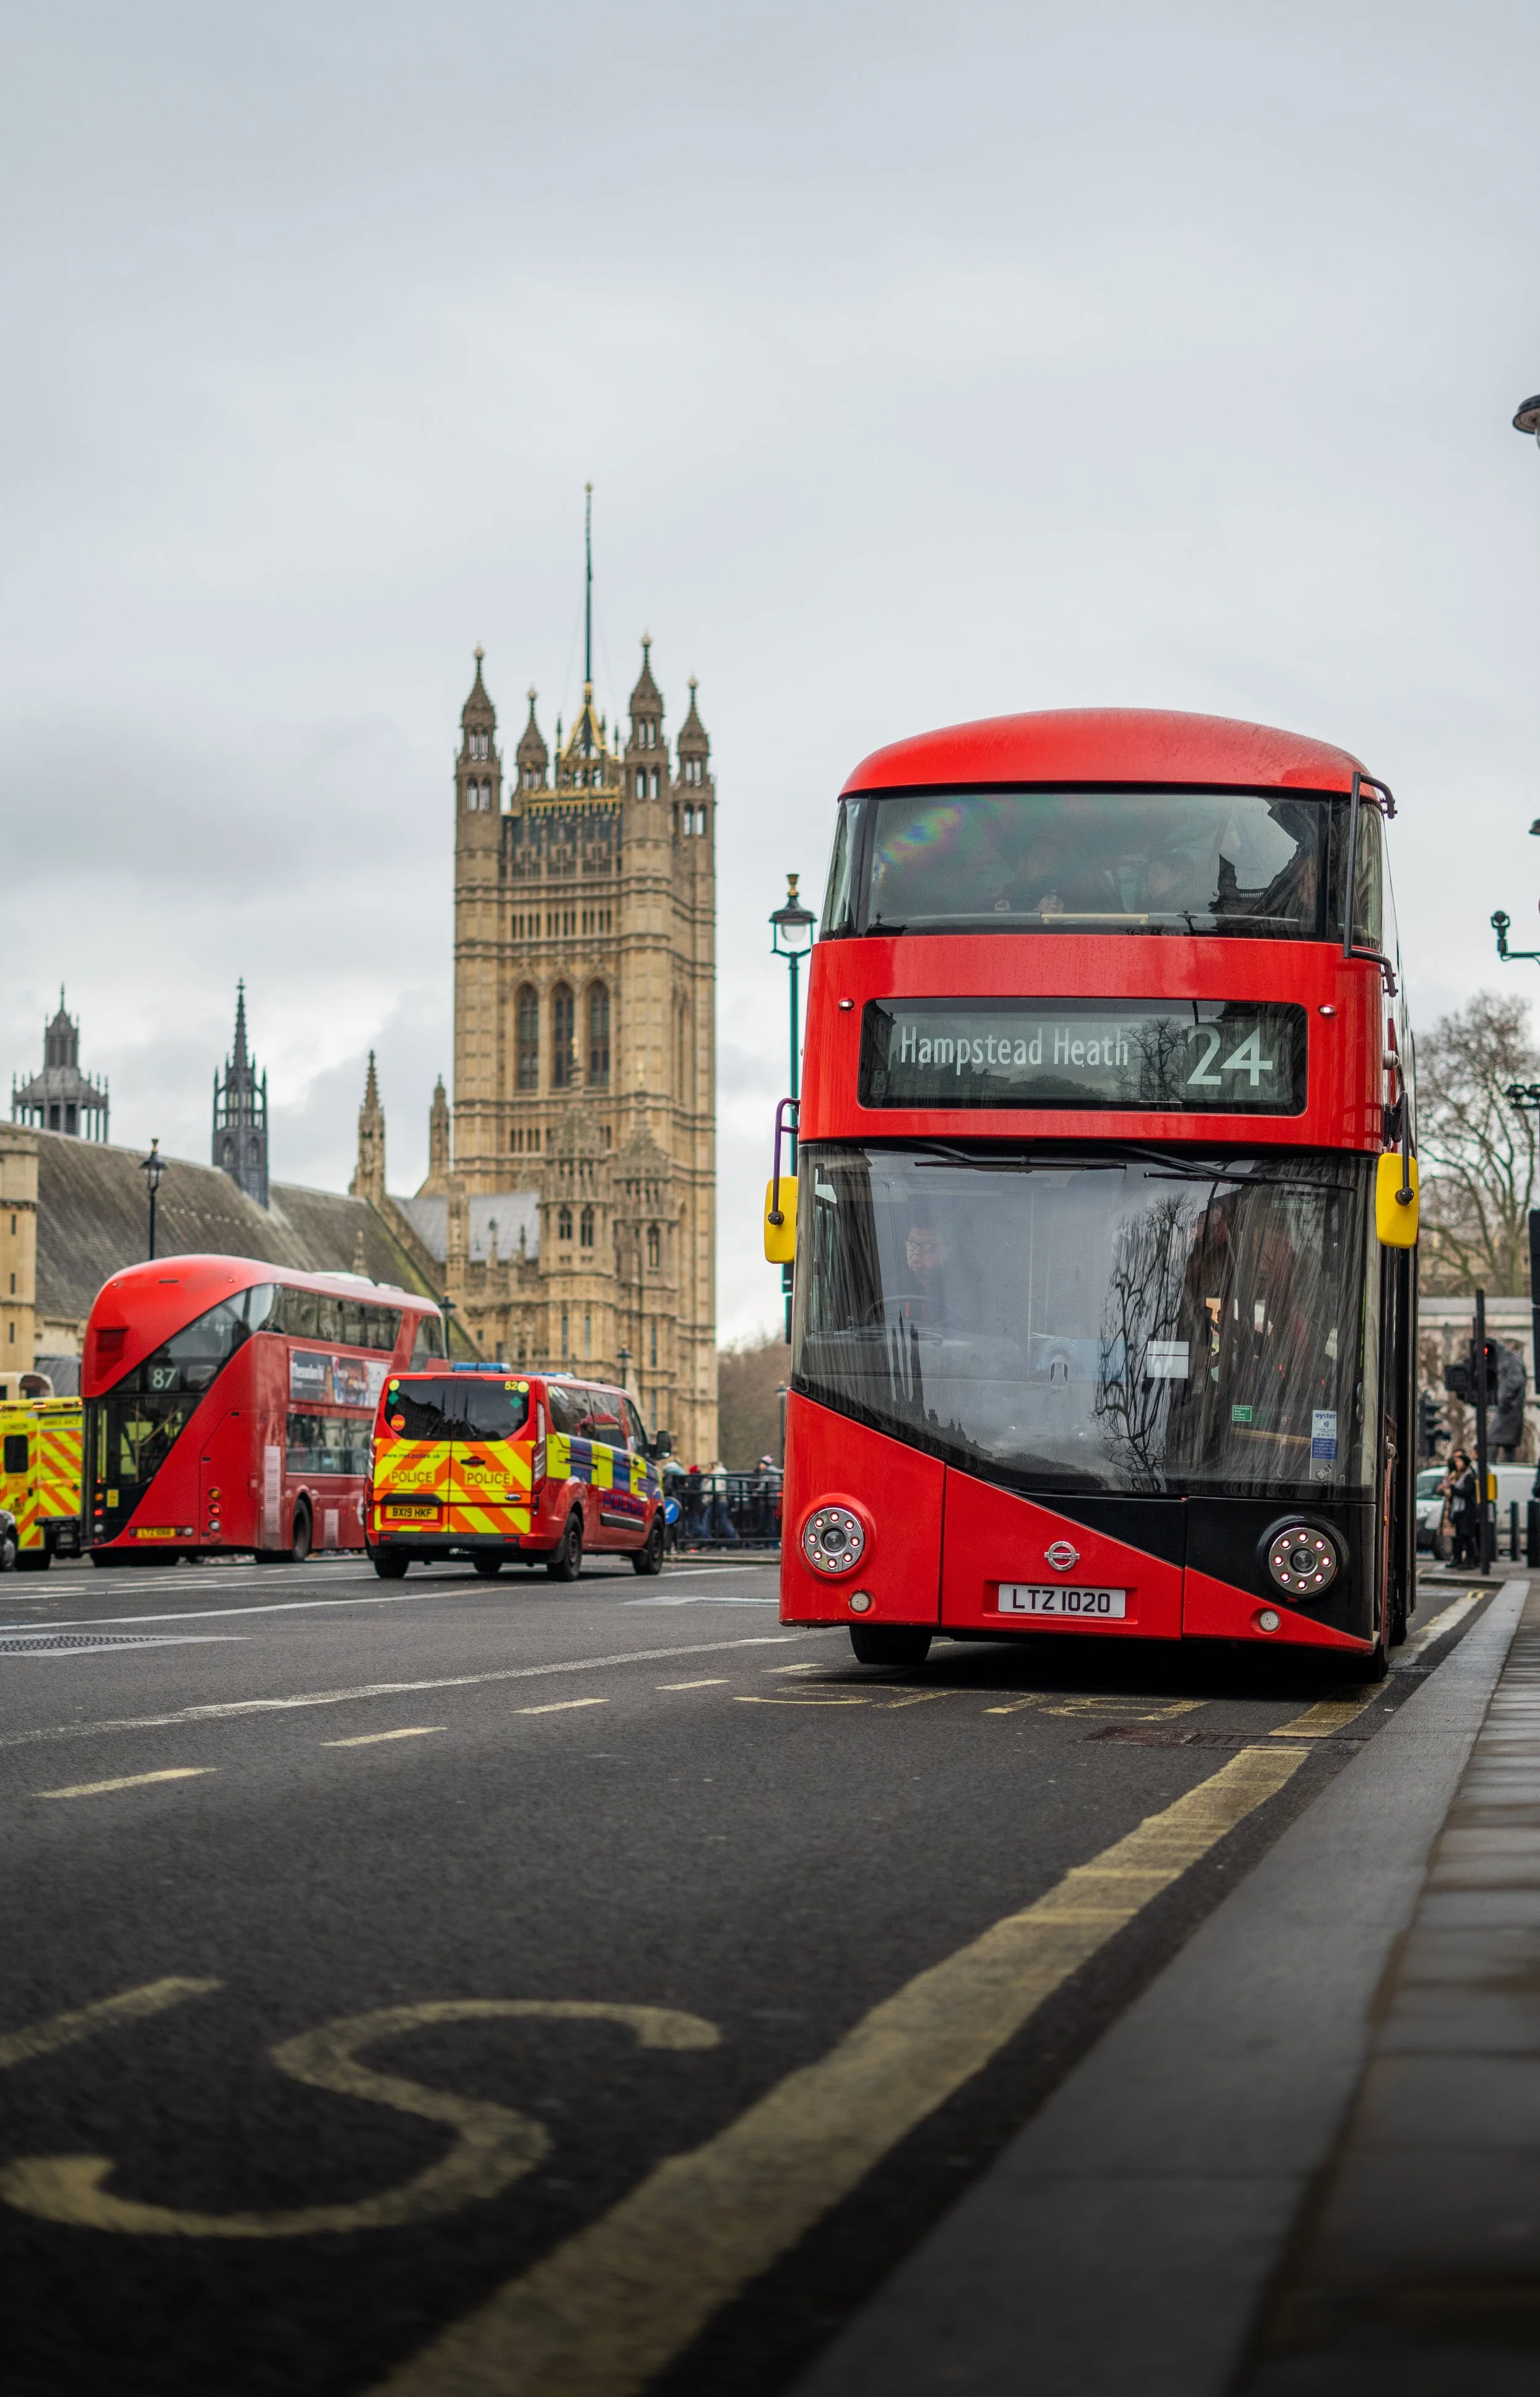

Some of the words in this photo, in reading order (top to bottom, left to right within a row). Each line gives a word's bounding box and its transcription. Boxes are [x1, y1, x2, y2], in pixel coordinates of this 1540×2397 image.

[901, 1026, 1043, 1076] Hampstead
[1053, 1027, 1129, 1067] Heath
[1186, 1025, 1273, 1086] 24
[153, 1368, 177, 1389] 87
[505, 1381, 518, 1390] 52
[391, 1472, 432, 1483] POLICE
[467, 1472, 511, 1484] POLICE
[392, 1507, 412, 1517] BX19
[414, 1507, 432, 1518] HKF
[603, 1491, 644, 1516] POLICE
[1012, 1589, 1055, 1610] LTZ
[1061, 1591, 1111, 1613] 1020
[732, 1685, 1211, 1721] BUS
